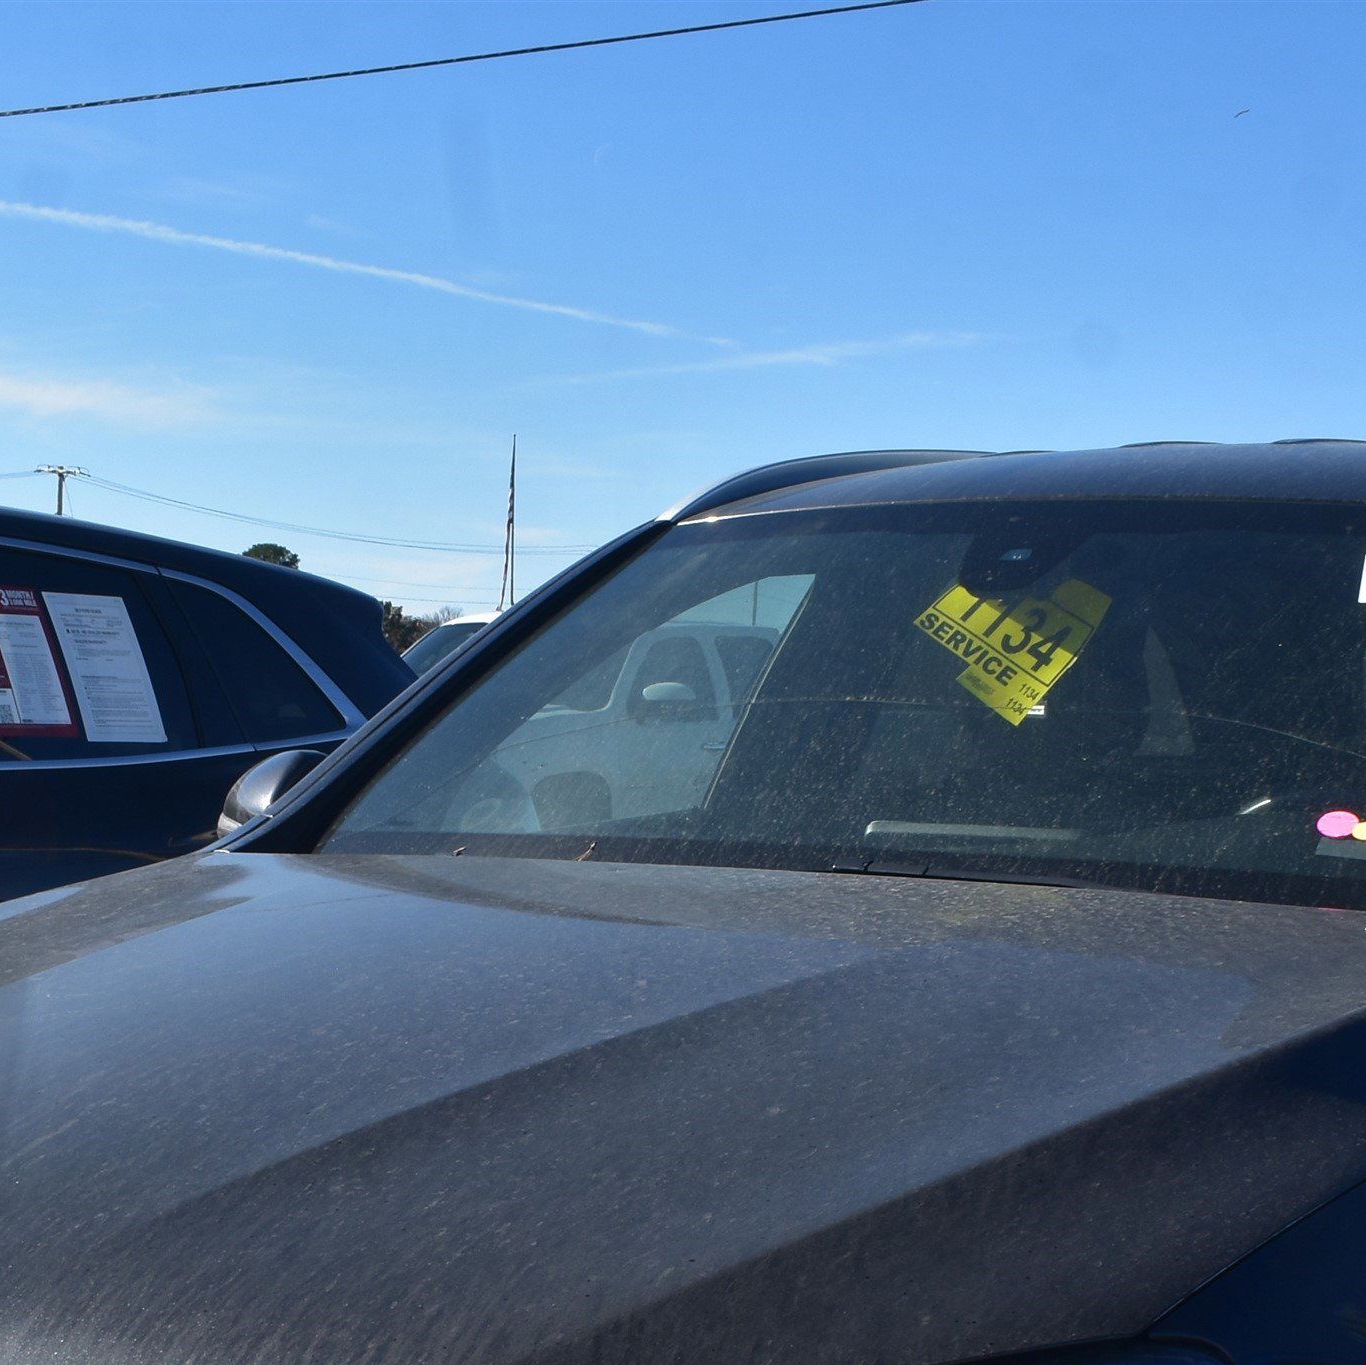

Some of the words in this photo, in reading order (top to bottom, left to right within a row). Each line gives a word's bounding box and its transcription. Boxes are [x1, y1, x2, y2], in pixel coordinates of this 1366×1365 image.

[919, 613, 1018, 687] SERVICE
[959, 598, 1073, 672] 1134
[1019, 683, 1040, 701] 1134
